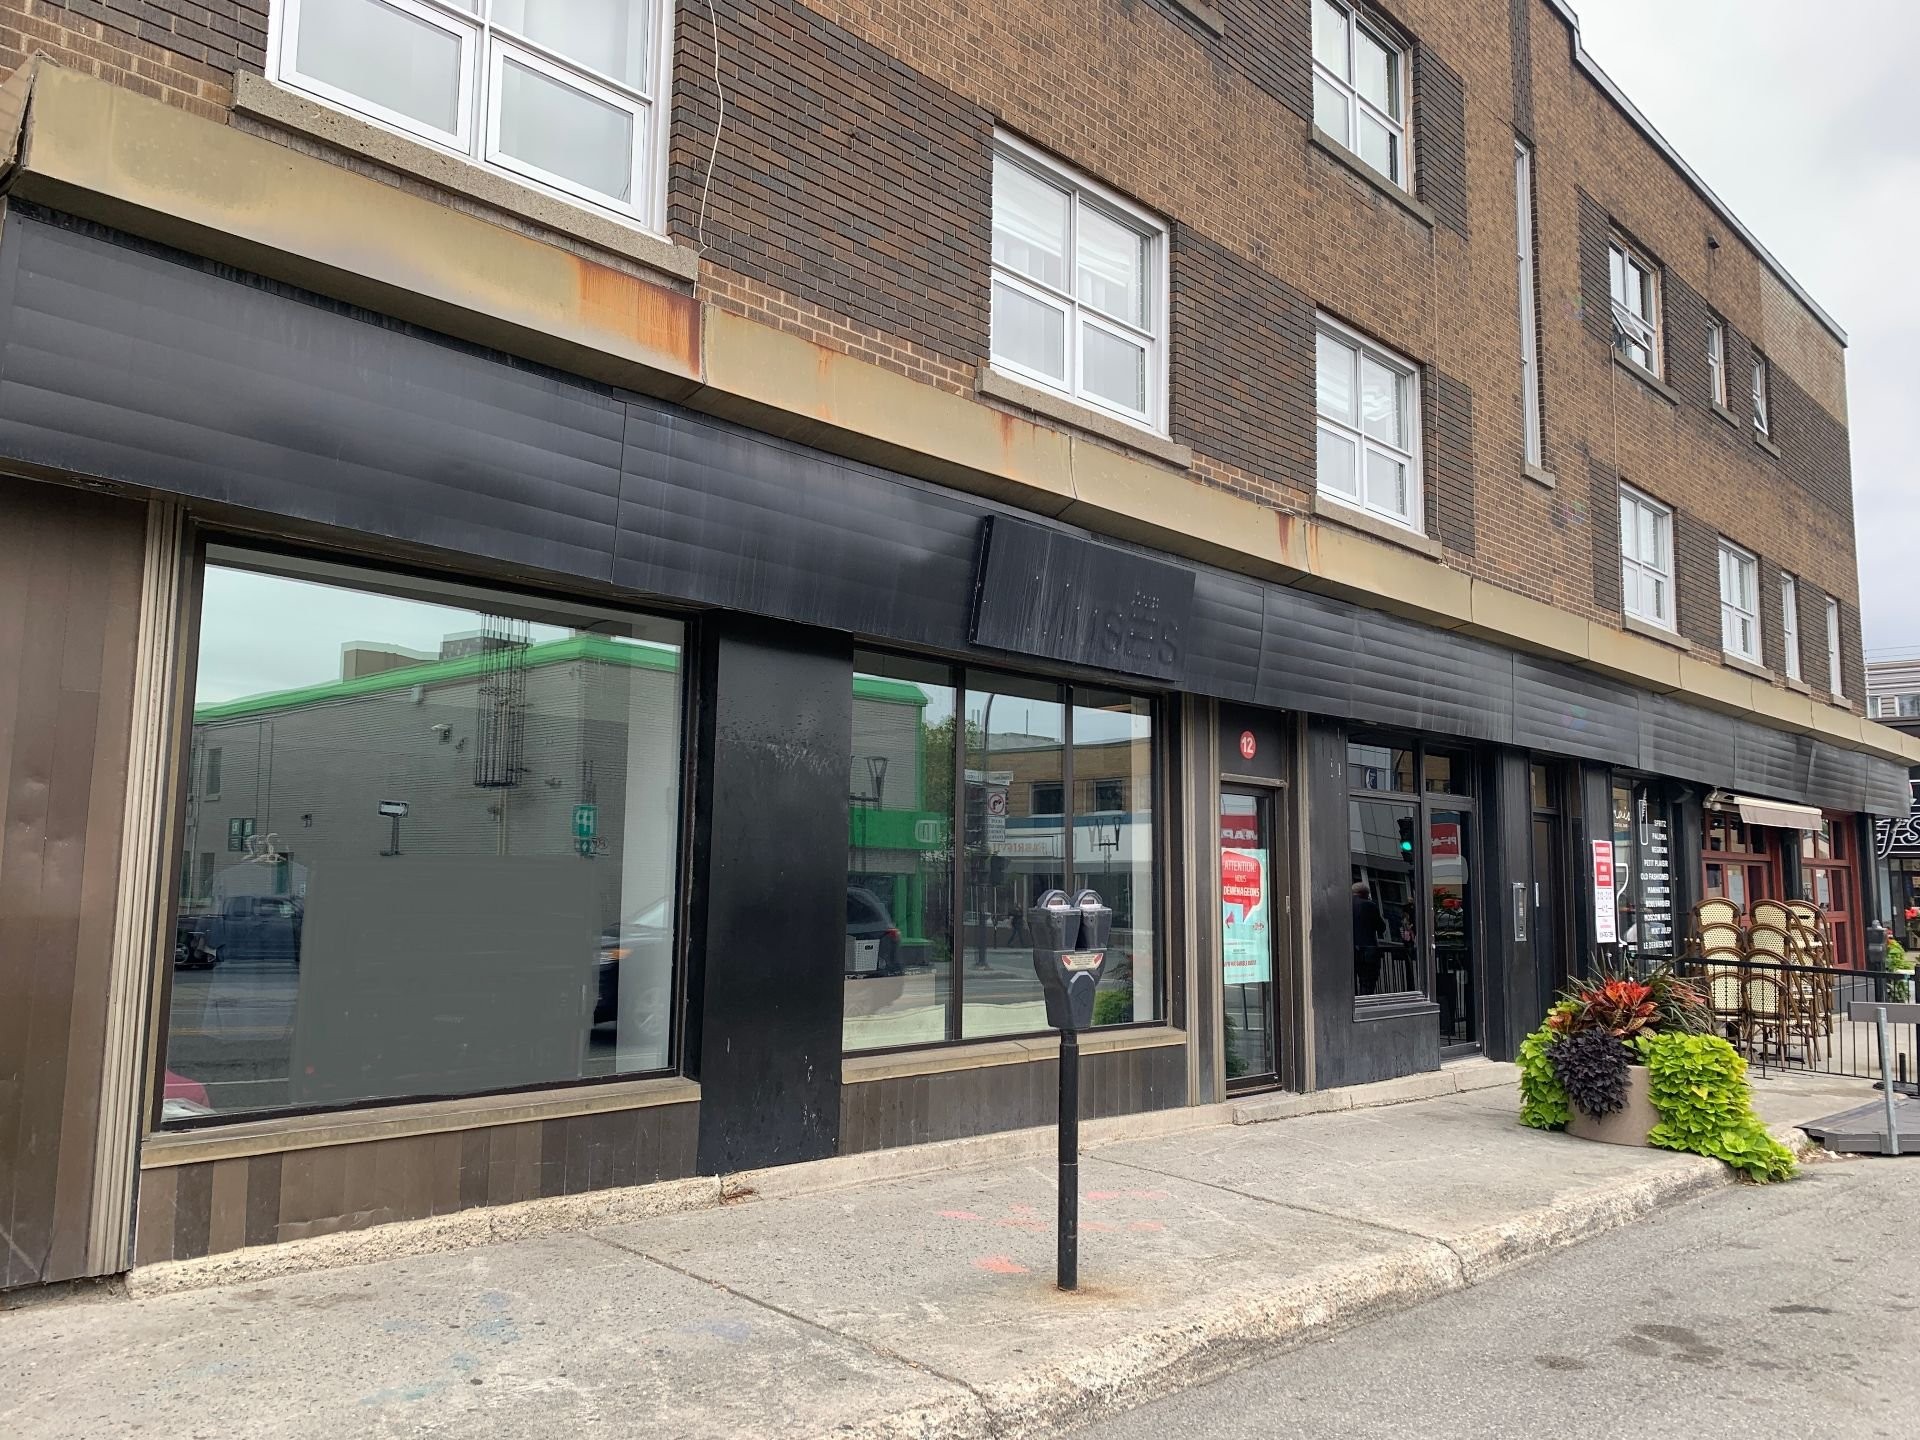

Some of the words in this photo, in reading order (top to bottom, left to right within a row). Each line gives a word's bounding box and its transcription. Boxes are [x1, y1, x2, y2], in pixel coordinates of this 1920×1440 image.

[1241, 736, 1254, 754] 12
[1653, 819, 1667, 827] SPRITZ
[1651, 832, 1667, 840] PALOMA
